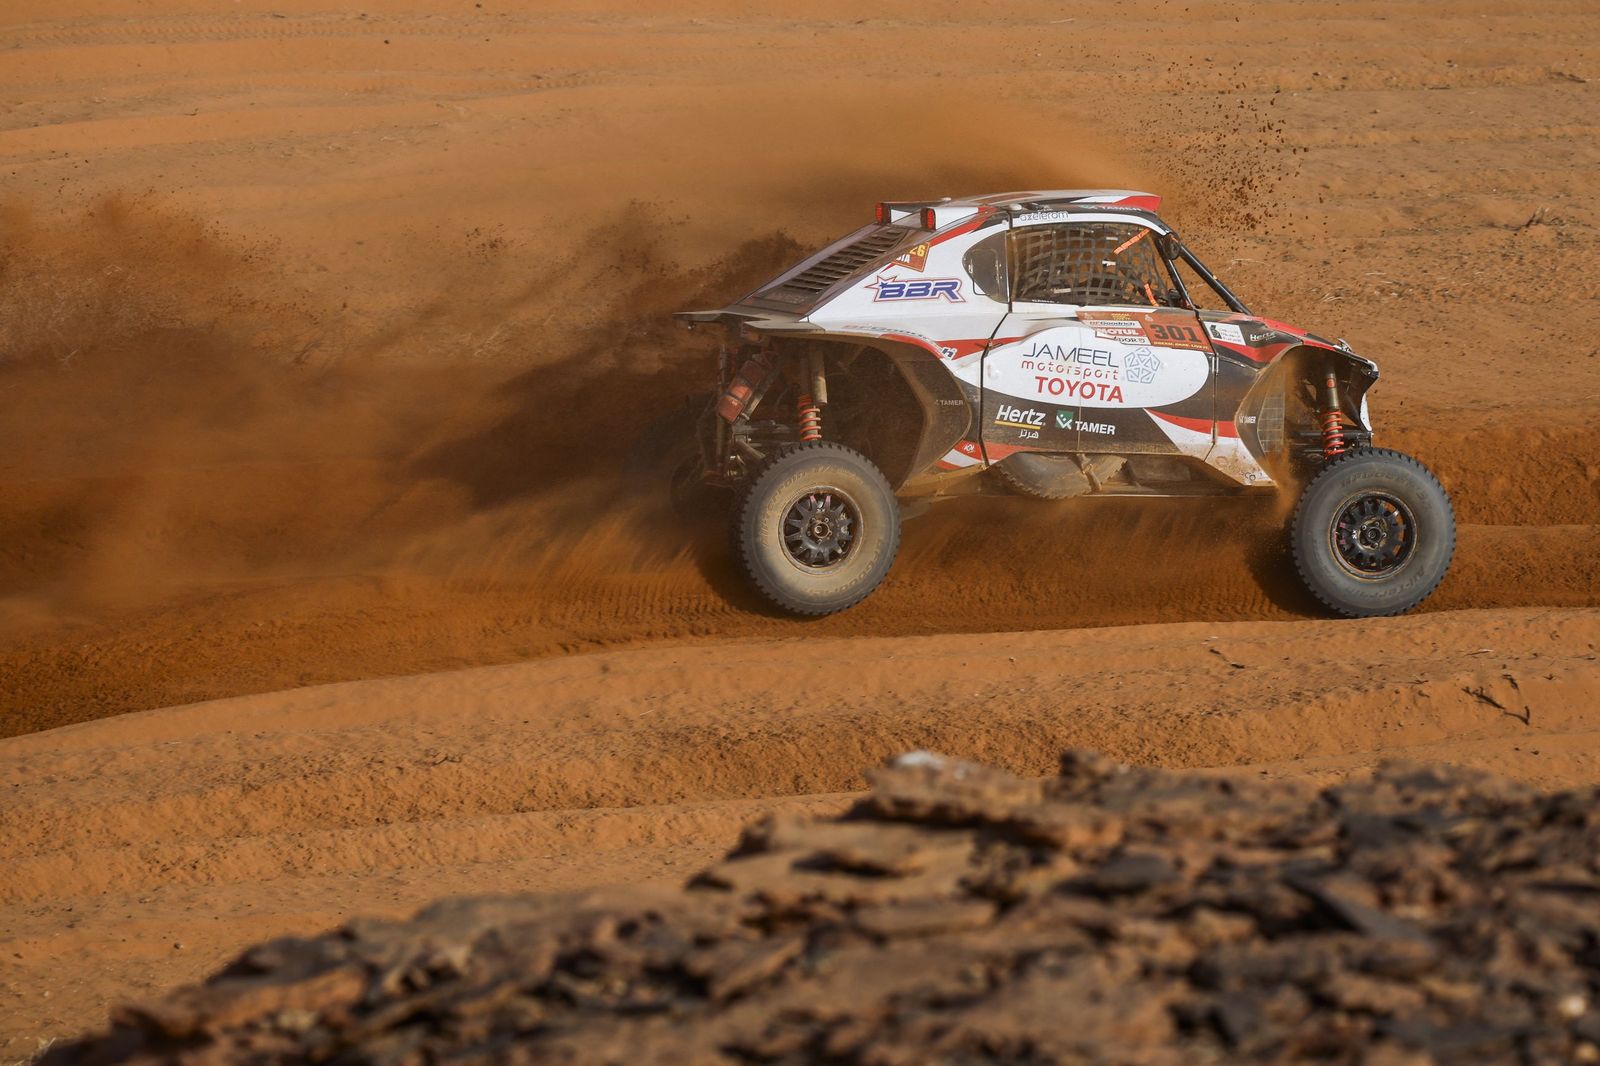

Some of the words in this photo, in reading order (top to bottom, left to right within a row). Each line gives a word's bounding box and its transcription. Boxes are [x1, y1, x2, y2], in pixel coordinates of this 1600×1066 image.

[879, 280, 960, 300] BBR
[1150, 323, 1203, 343] 301
[1022, 342, 1119, 368] JAMEEL
[1021, 359, 1119, 381] motorsport
[1035, 375, 1124, 403] TOYOTA
[996, 404, 1045, 426] Hertz
[1019, 429, 1040, 440] هرتز
[1075, 421, 1115, 435] TAMER
